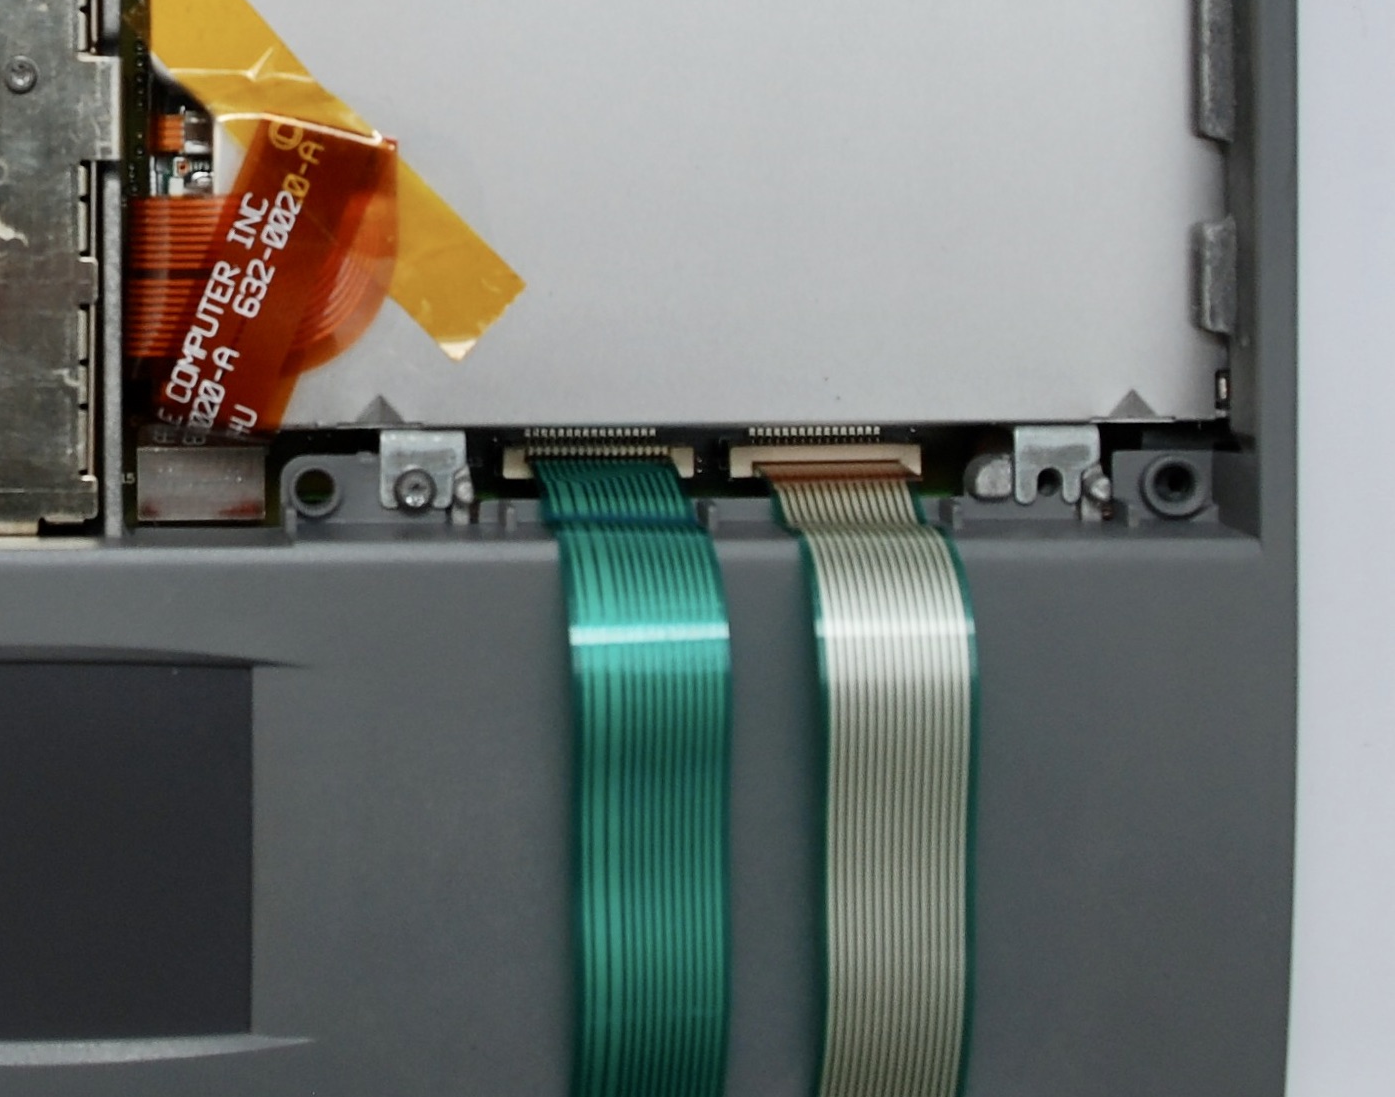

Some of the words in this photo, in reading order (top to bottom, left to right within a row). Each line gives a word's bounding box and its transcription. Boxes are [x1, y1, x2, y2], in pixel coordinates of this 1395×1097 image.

[165, 260, 242, 404] COMPUTER
[226, 191, 270, 250] INC
[231, 139, 325, 319] 632-0020-A
